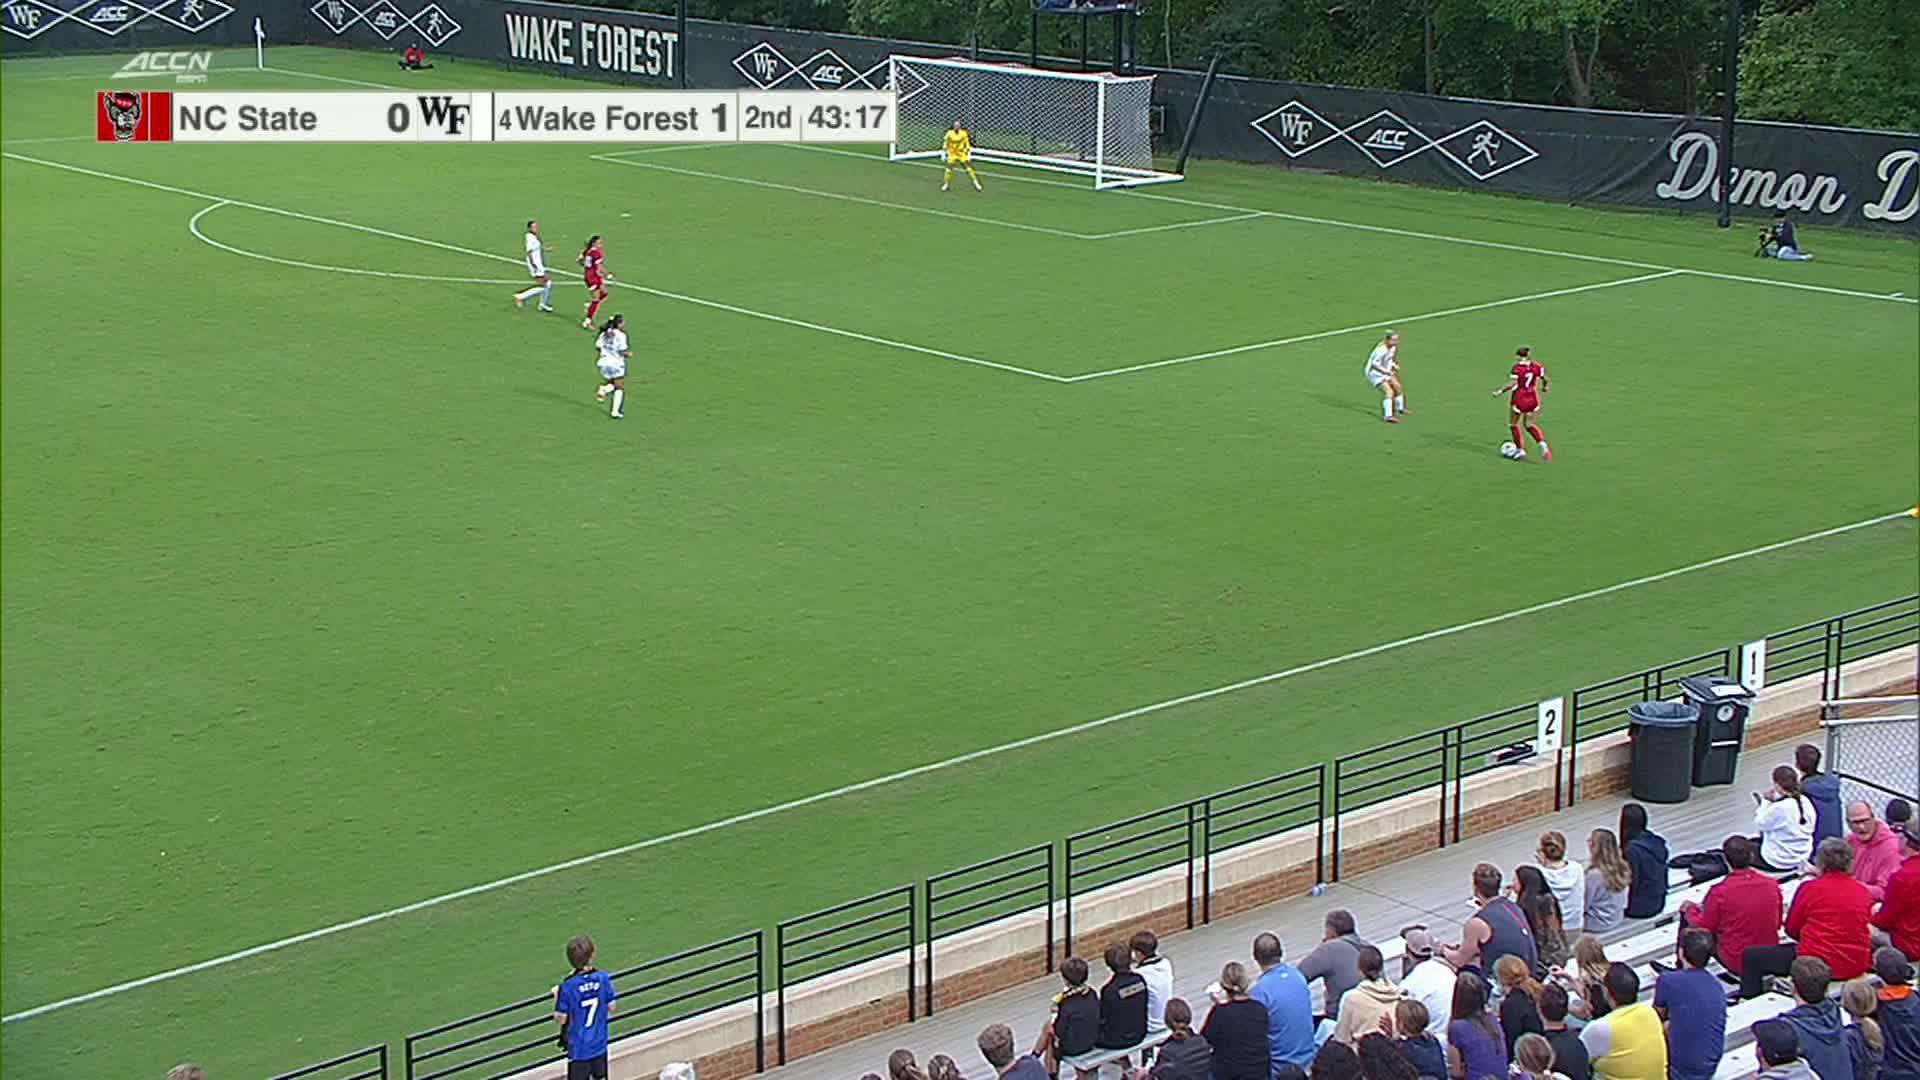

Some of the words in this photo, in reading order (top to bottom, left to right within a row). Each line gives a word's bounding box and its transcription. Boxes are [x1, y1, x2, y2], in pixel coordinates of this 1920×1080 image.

[91, 6, 129, 22] ACC
[506, 13, 574, 65] WAKE
[581, 22, 678, 78] FOREST
[753, 52, 778, 81] WF
[811, 65, 844, 84] ACC
[1280, 113, 1313, 145] WF
[1363, 128, 1409, 150] ACC
[1525, 372, 1533, 388] 7
[1751, 651, 1757, 675] 1
[1544, 709, 1557, 736] 2
[581, 997, 600, 1028] 7
